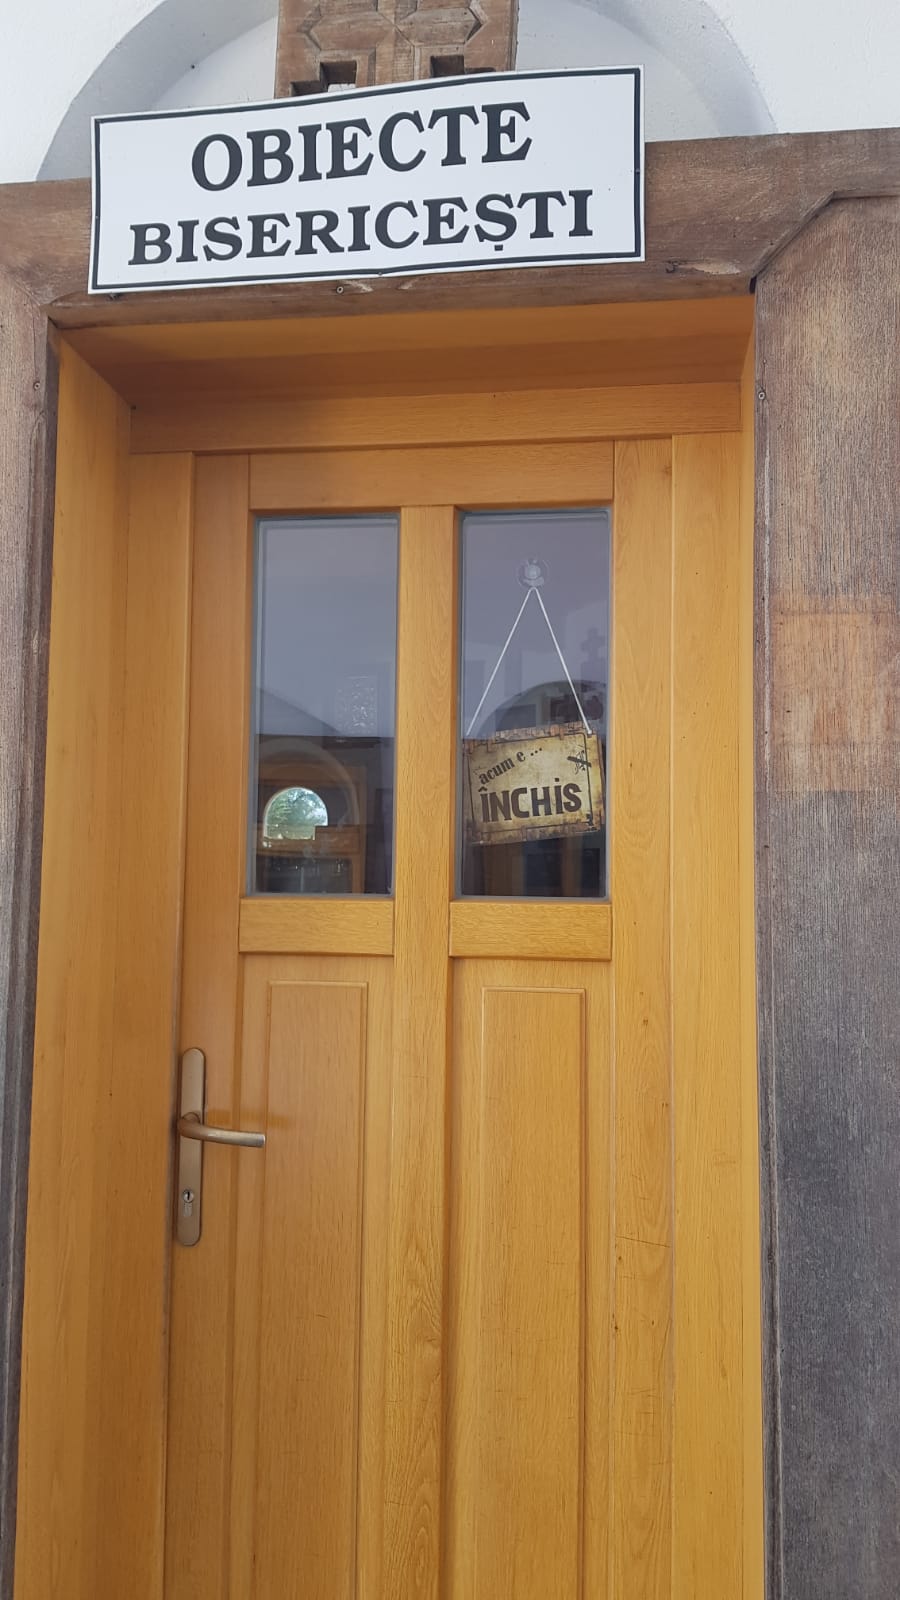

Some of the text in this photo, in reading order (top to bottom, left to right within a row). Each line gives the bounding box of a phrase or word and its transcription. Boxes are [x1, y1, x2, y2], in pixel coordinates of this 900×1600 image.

[191, 101, 533, 192] OBIECTE
[127, 189, 593, 266] BISERICEȘTI
[479, 757, 515, 785] acum
